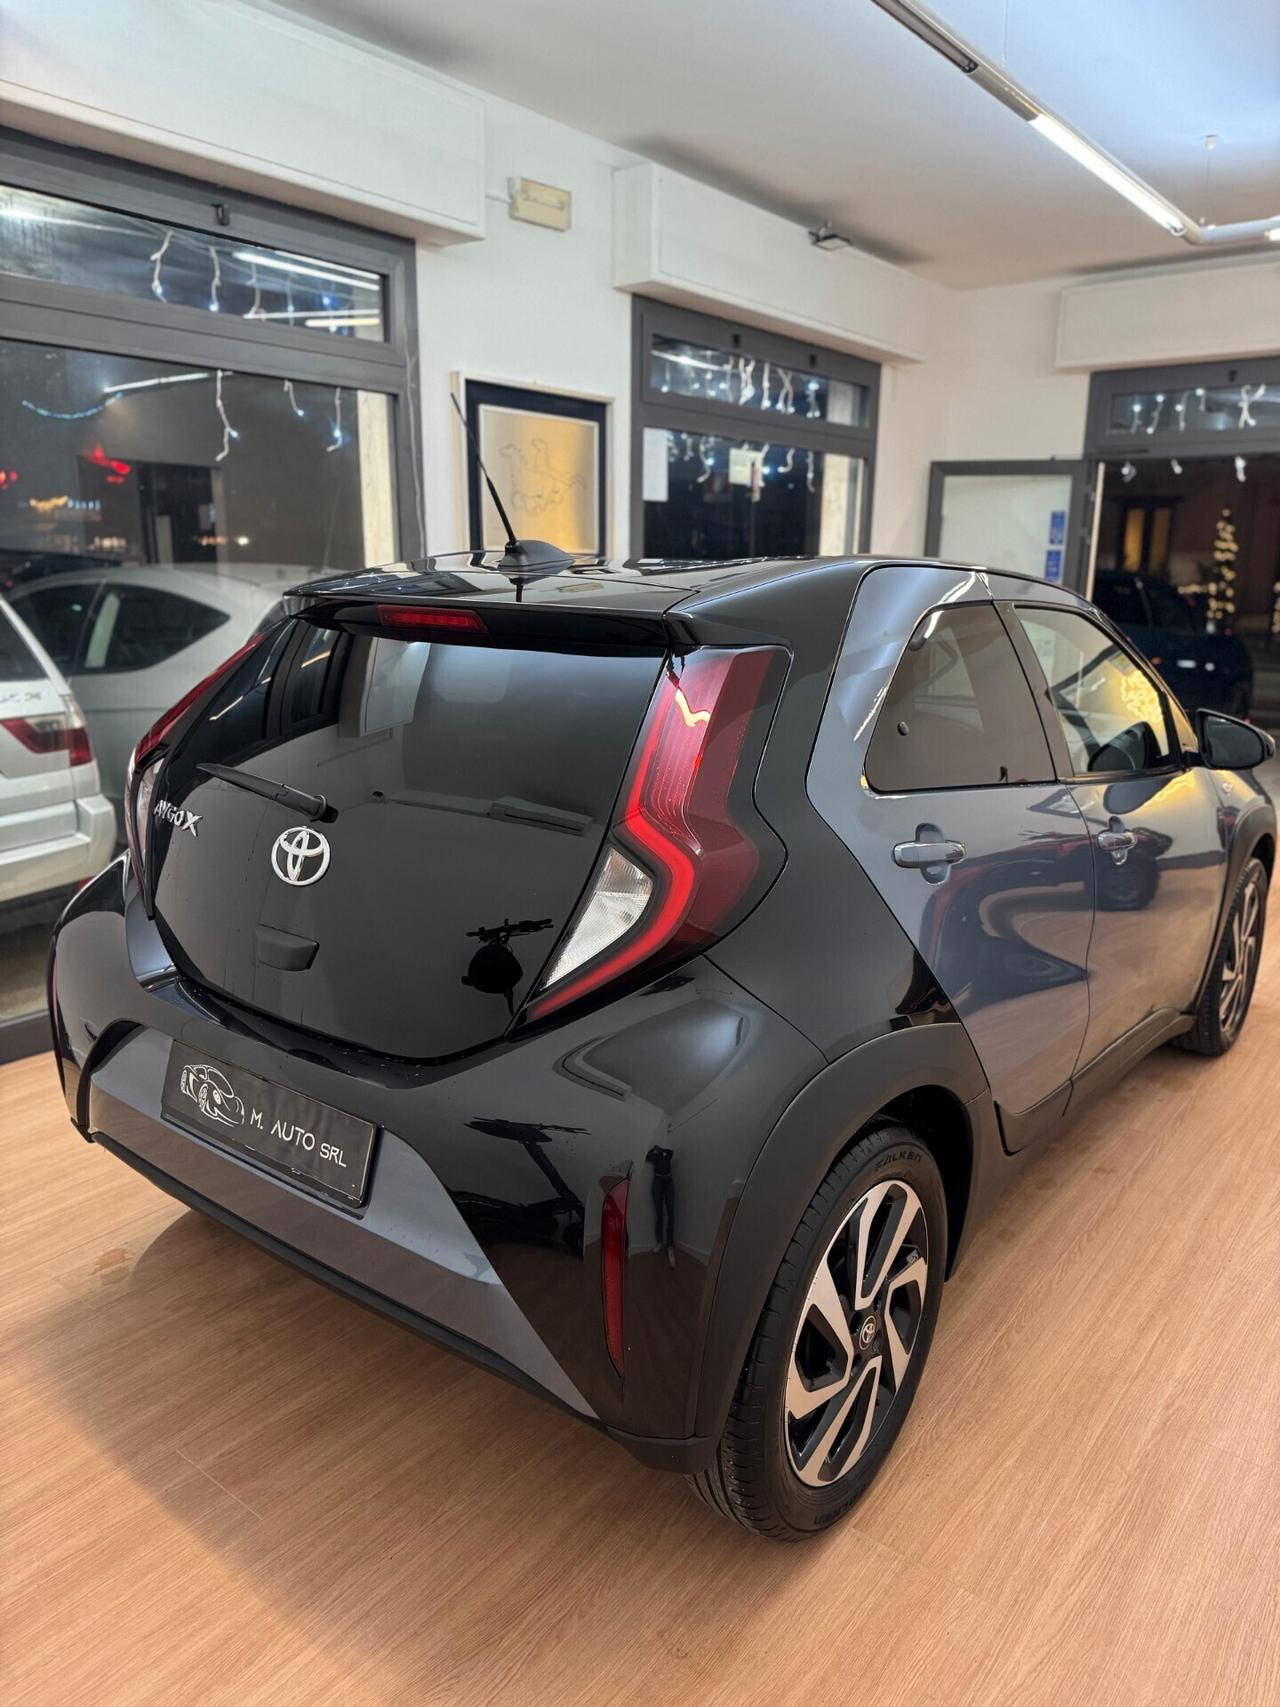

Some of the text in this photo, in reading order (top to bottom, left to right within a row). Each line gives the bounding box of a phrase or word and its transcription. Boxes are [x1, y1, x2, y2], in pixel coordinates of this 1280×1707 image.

[250, 1107, 347, 1168] M. AUTO SRL
